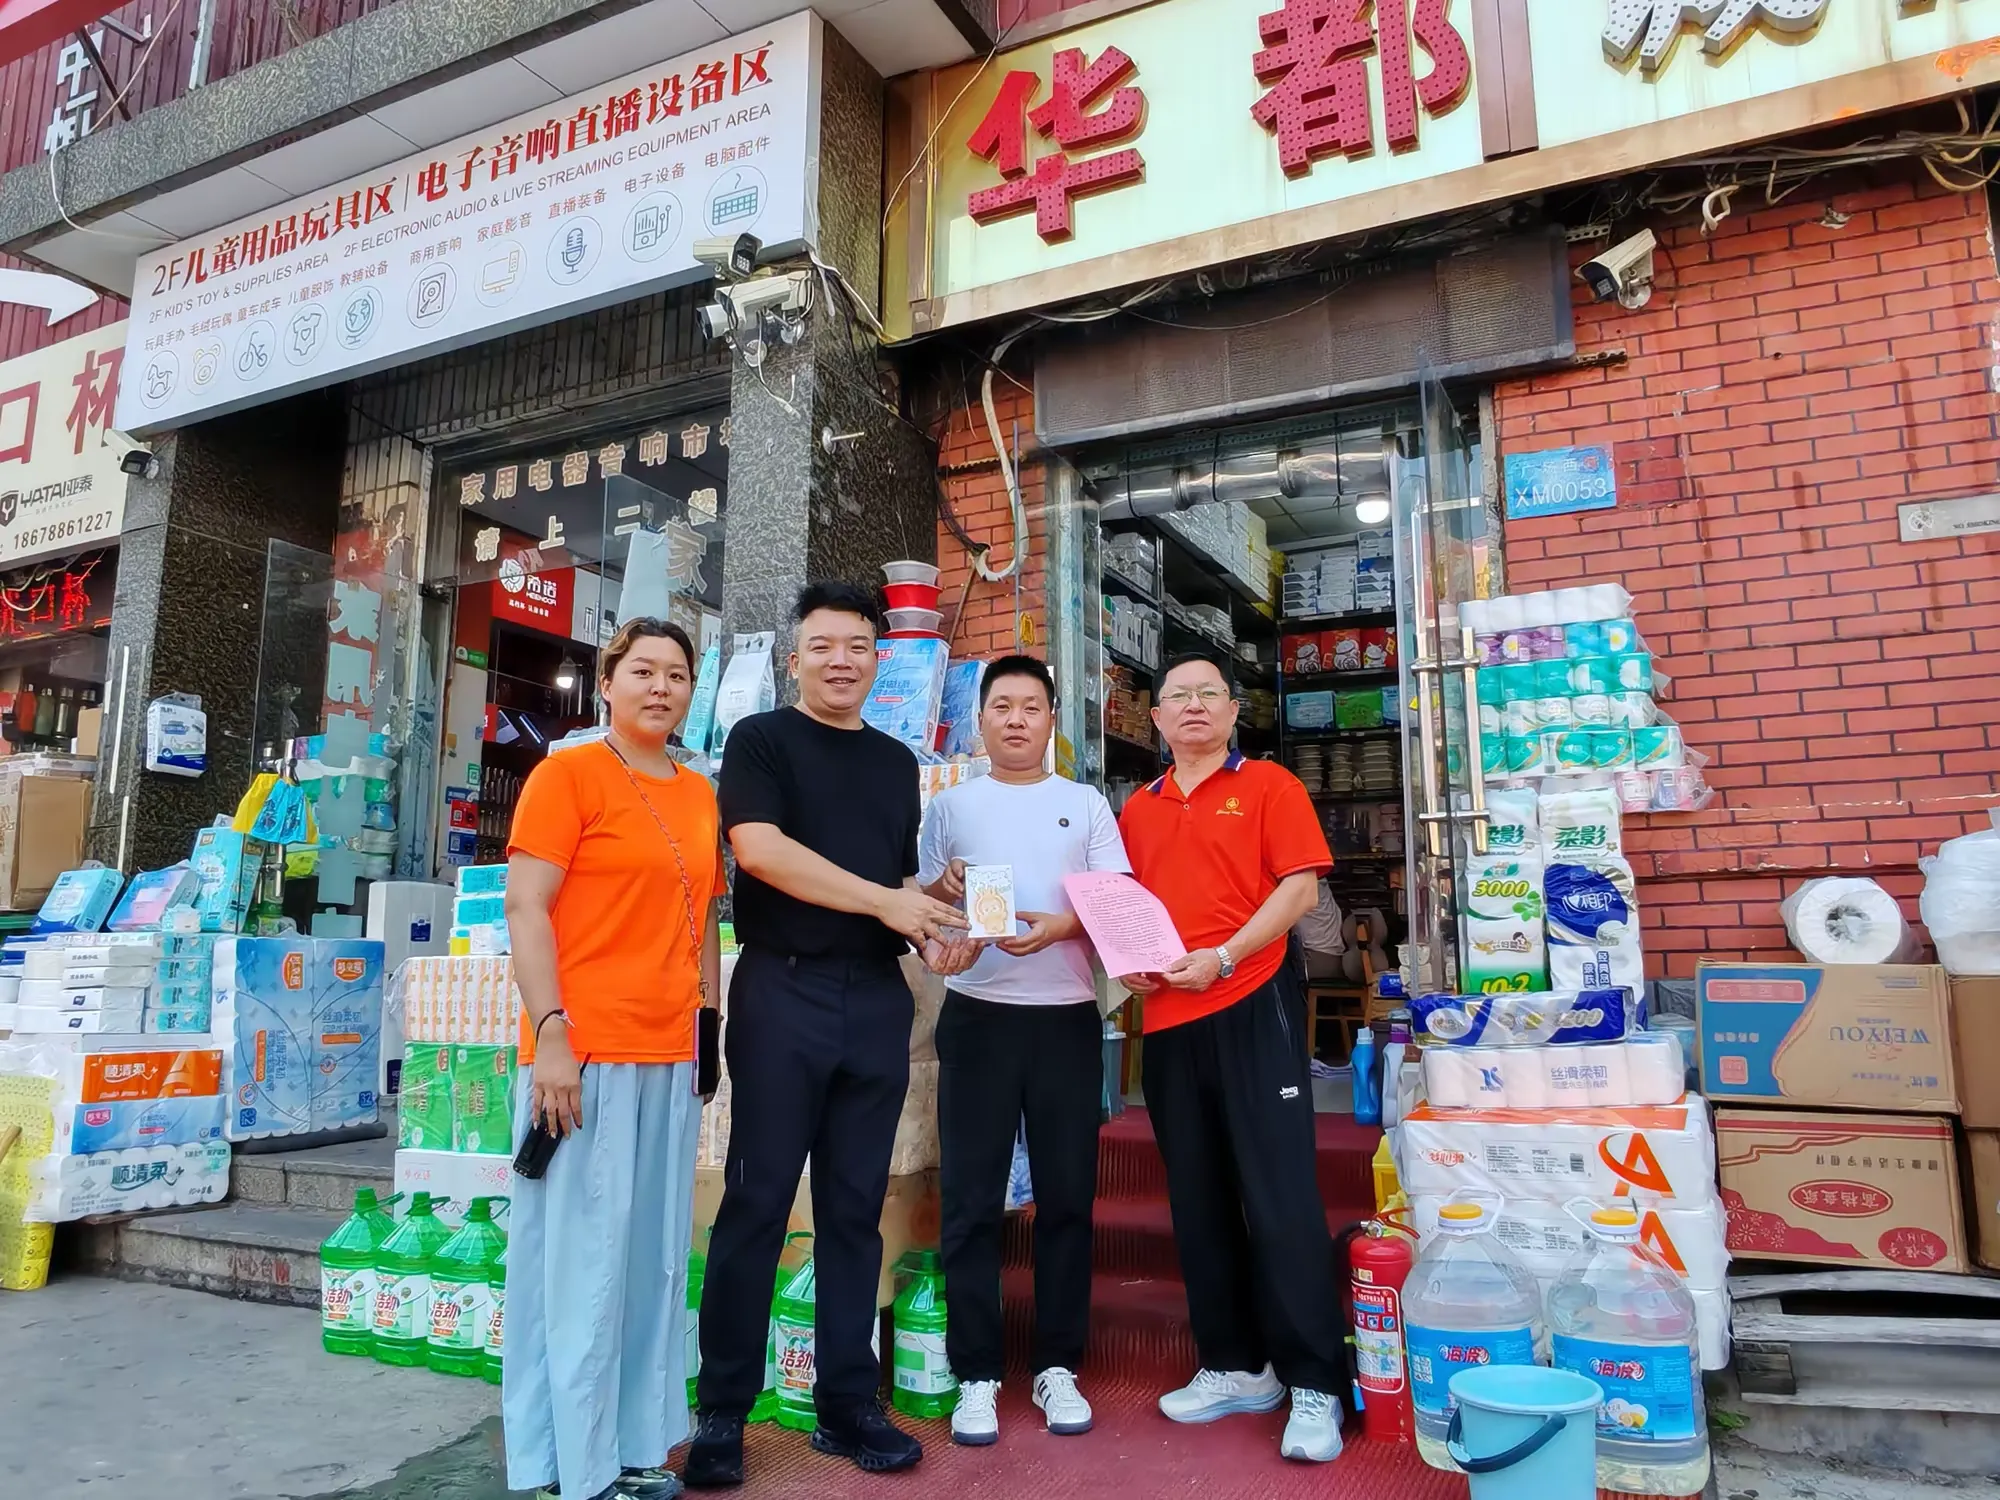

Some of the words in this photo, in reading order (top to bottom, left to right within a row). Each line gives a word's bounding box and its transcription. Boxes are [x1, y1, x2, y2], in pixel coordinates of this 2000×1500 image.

[966, 0, 1472, 246] 华都
[151, 182, 396, 297] 2F儿童用品玩具区
[417, 41, 774, 203] 电子音响直播设备区
[344, 242, 359, 258] 2F
[361, 212, 442, 252] ELECTRONIC
[445, 198, 487, 222] AUDIO
[490, 194, 499, 208] &
[503, 182, 533, 203] LIVE
[537, 151, 624, 191] STREAMING
[628, 117, 722, 161] EQUIPMENT
[725, 103, 772, 129] AREA
[144, 330, 185, 352] 玩具手办
[189, 311, 233, 337] 毛绒玩偶
[287, 279, 335, 305] 儿童服饰
[340, 260, 389, 289] 教辅设备
[410, 236, 462, 266] 商用音响
[477, 212, 532, 242] 家庭影音
[548, 187, 607, 219] 直播装备
[624, 162, 687, 194] 电子设备
[704, 135, 771, 169] 电脑配件
[149, 308, 164, 324] 2F
[165, 295, 194, 316] KID'S
[196, 289, 221, 308] TOY
[223, 284, 232, 298] &
[233, 265, 292, 296] SUPPLIES
[295, 253, 329, 275] AREA
[1515, 478, 1607, 509] XM0053
[14, 511, 113, 550] 18678861227
[1552, 824, 1606, 850] 柔影
[1472, 880, 1530, 897] 3000
[1828, 1026, 1931, 1046] WEIYOU
[1551, 1065, 1608, 1080] 丝滑柔韧
[112, 1160, 168, 1186] 顺清柔
[1801, 1188, 1880, 1208] 高档盘纸
[326, 1287, 350, 1304] 洁劲
[375, 1292, 397, 1310] 洁劲
[431, 1301, 459, 1320] 洁劲
[780, 1346, 813, 1370] 洁劲
